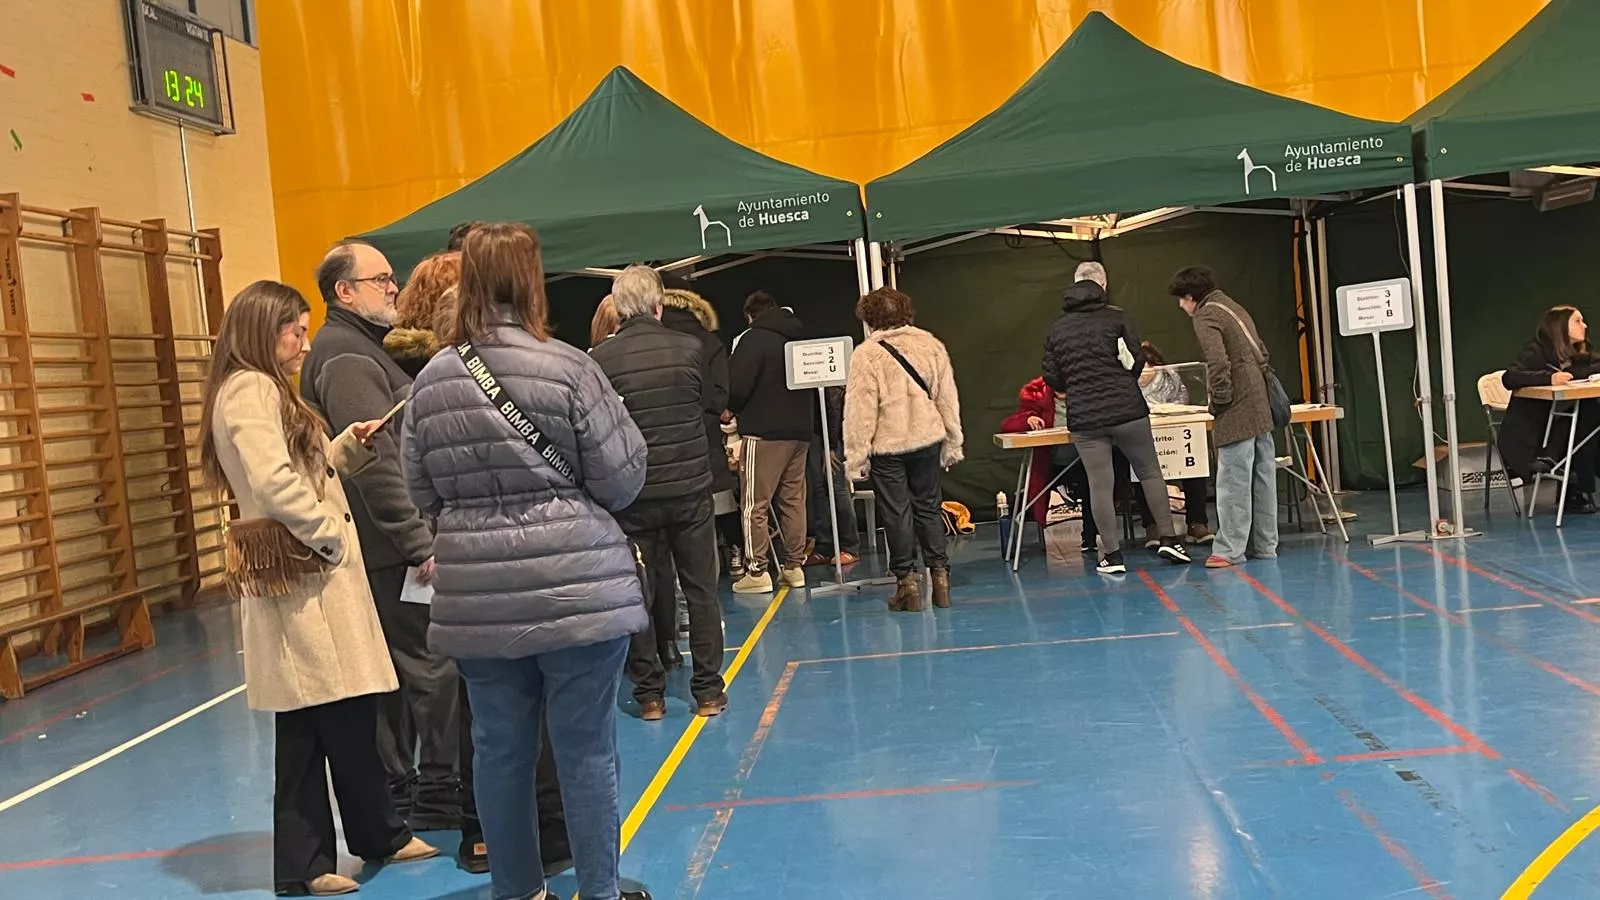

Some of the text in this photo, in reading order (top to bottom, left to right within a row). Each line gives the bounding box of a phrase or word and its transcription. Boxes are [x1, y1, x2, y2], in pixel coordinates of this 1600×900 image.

[164, 70, 204, 108] 13 24
[1284, 137, 1383, 159] Ayuntamiento
[1285, 155, 1361, 172] de Huesca
[737, 191, 830, 214] Ayuntamiento
[738, 210, 809, 228] de Huesca
[1386, 299, 1391, 308] 1
[1386, 309, 1393, 317] B
[828, 346, 834, 354] 3
[828, 356, 835, 364] 2
[829, 364, 836, 373] U
[465, 355, 501, 400] BIMBA
[500, 400, 541, 445] BIMBA
[1155, 429, 1192, 443] trito: 3
[1184, 442, 1191, 454] 1
[1185, 456, 1196, 467] B
